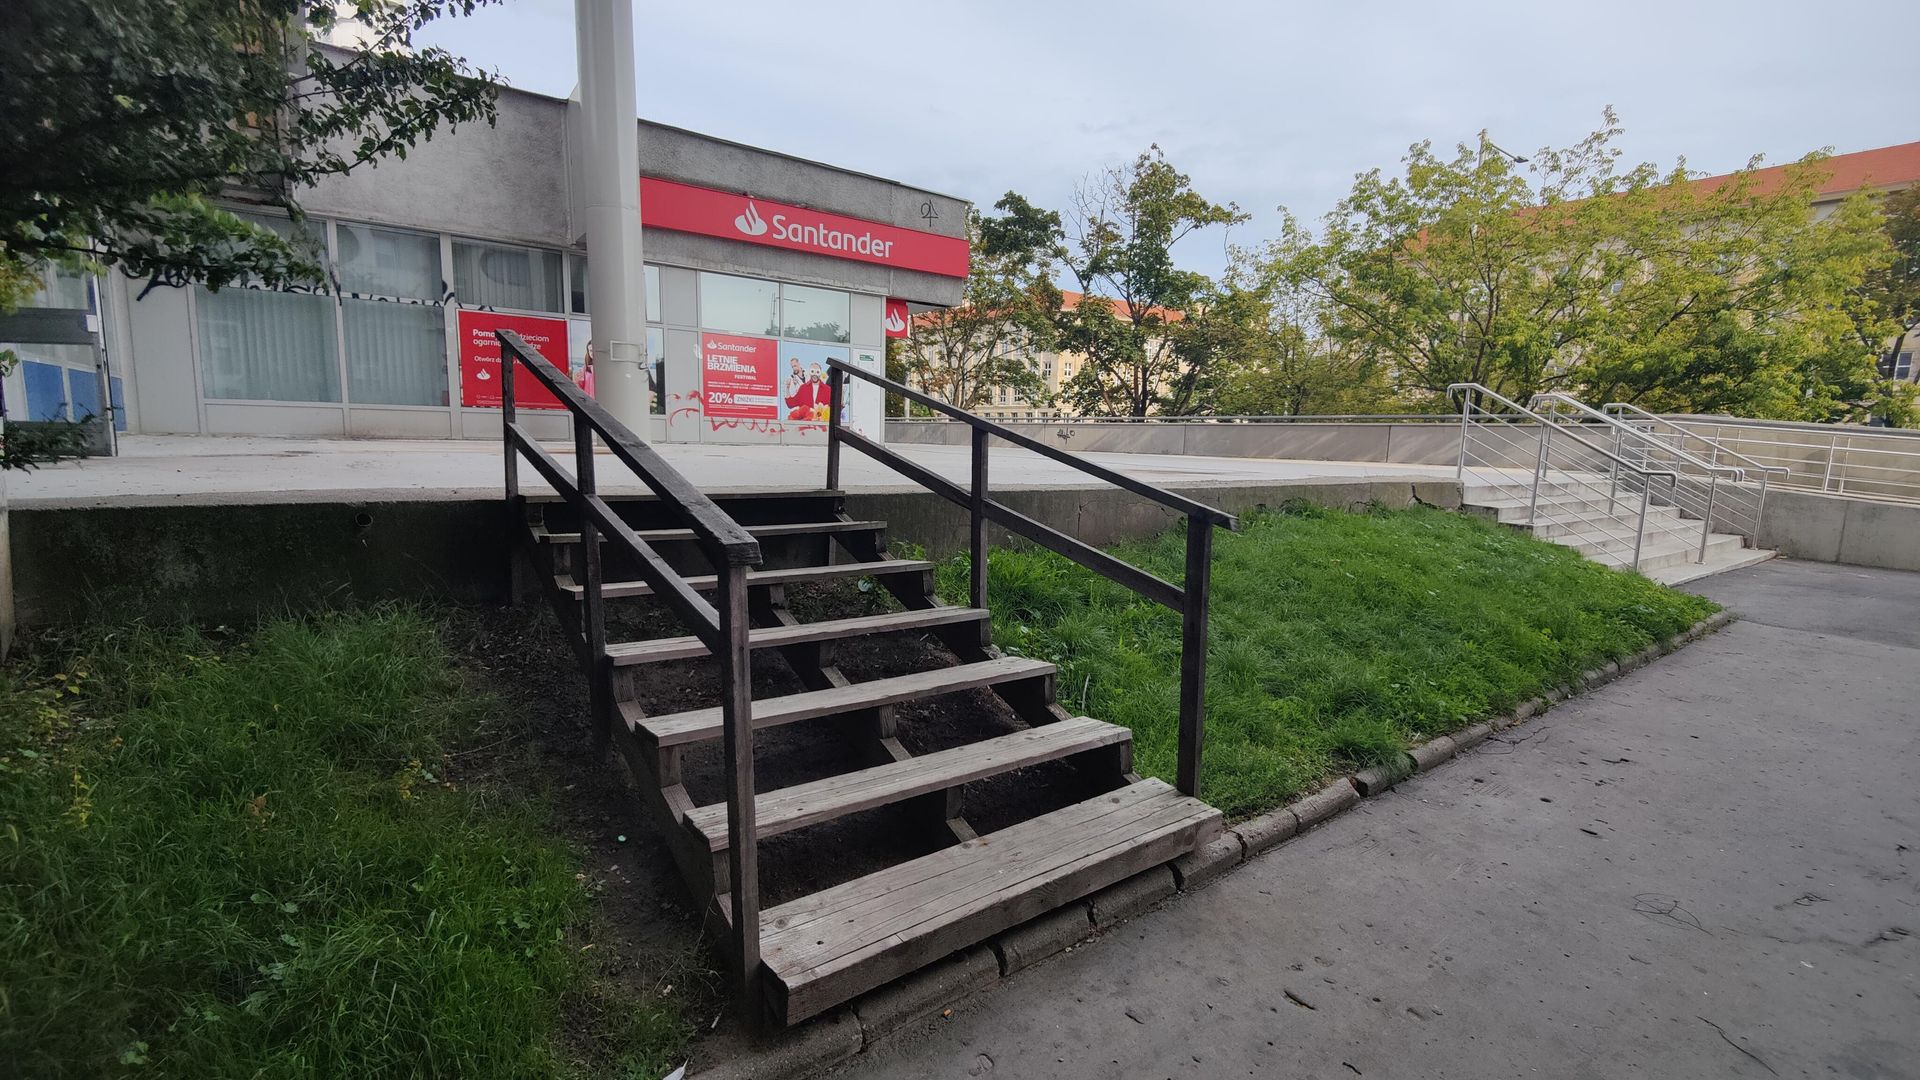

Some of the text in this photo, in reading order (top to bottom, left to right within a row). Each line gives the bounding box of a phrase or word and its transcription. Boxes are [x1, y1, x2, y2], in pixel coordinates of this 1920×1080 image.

[772, 214, 894, 258] Santander
[717, 342, 757, 353] Santander
[707, 354, 739, 365] LETNIE
[707, 362, 757, 374] BRZMIENIA
[708, 391, 733, 404] 20%
